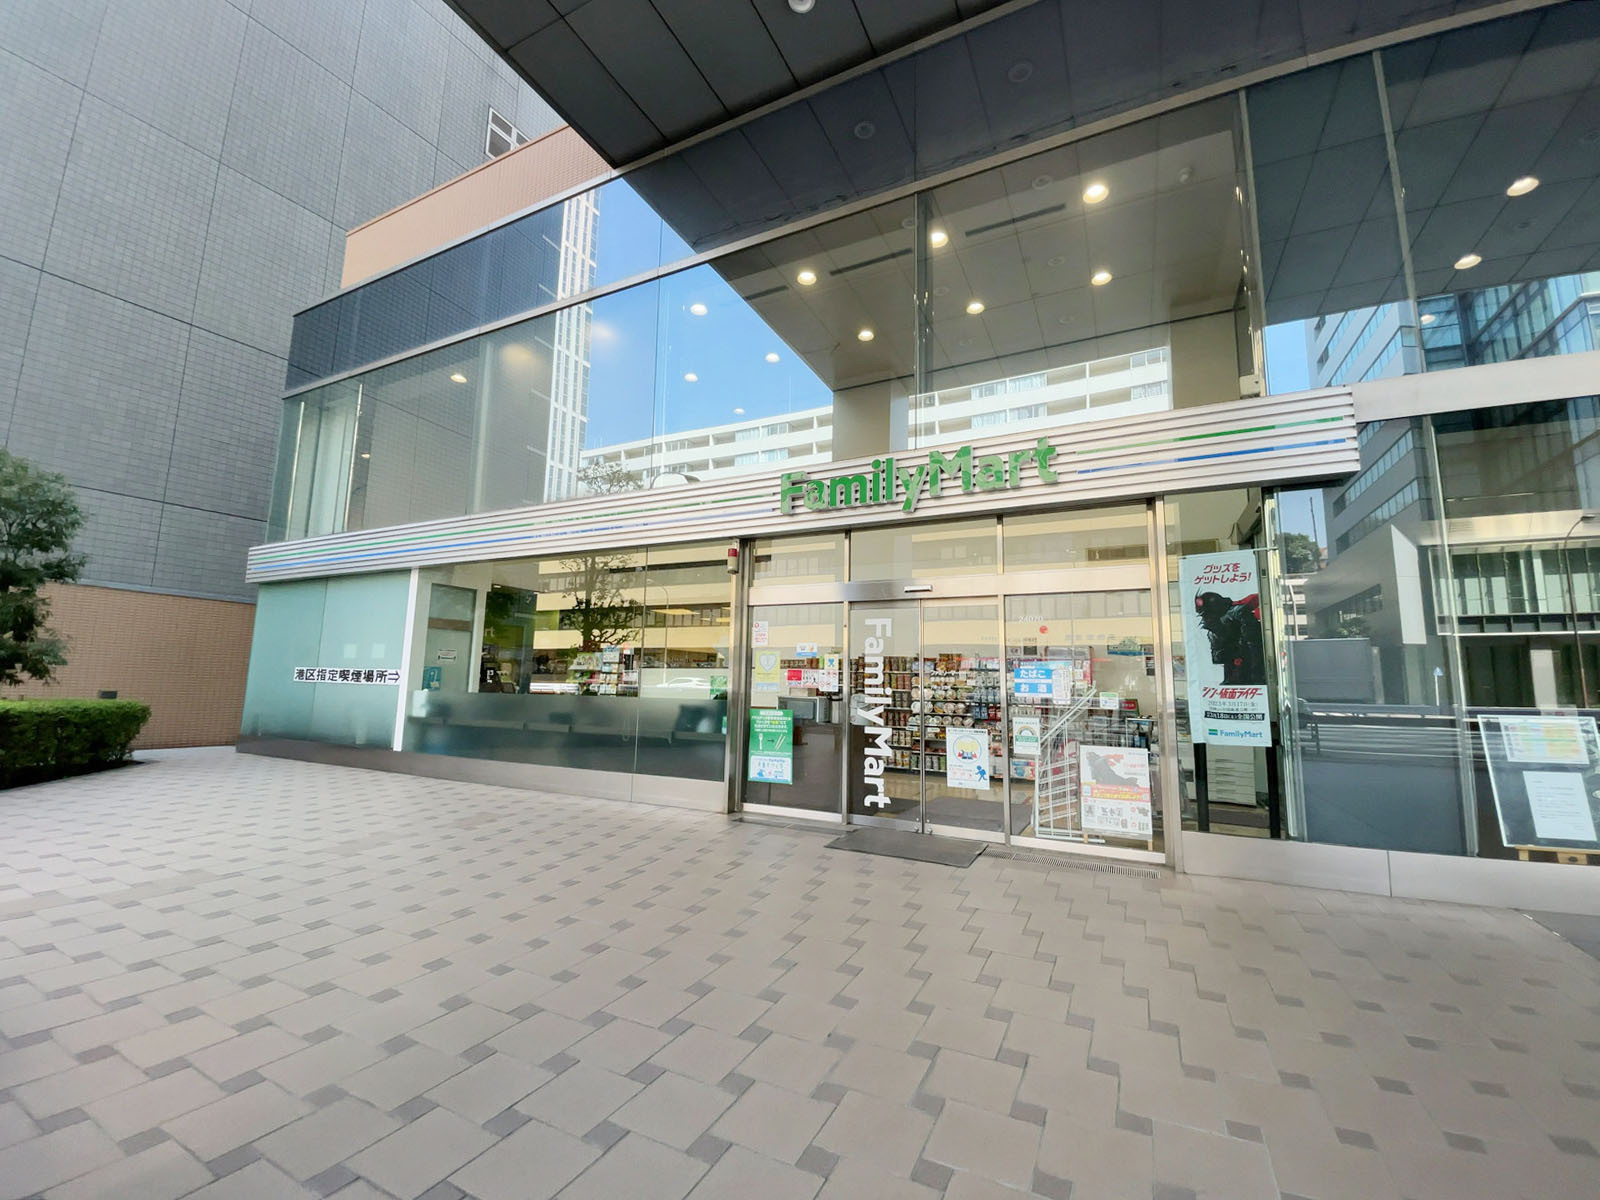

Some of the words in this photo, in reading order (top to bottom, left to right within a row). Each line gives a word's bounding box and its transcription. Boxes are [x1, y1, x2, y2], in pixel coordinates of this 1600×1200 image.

[780, 436, 1058, 515] FamilyMart
[1203, 562, 1241, 575] グッズを
[294, 668, 388, 684] 港区指定喫煙場所
[1020, 669, 1047, 679] たばこ
[857, 617, 892, 809] FamilyMart
[1220, 729, 1263, 739] FamilyMart
